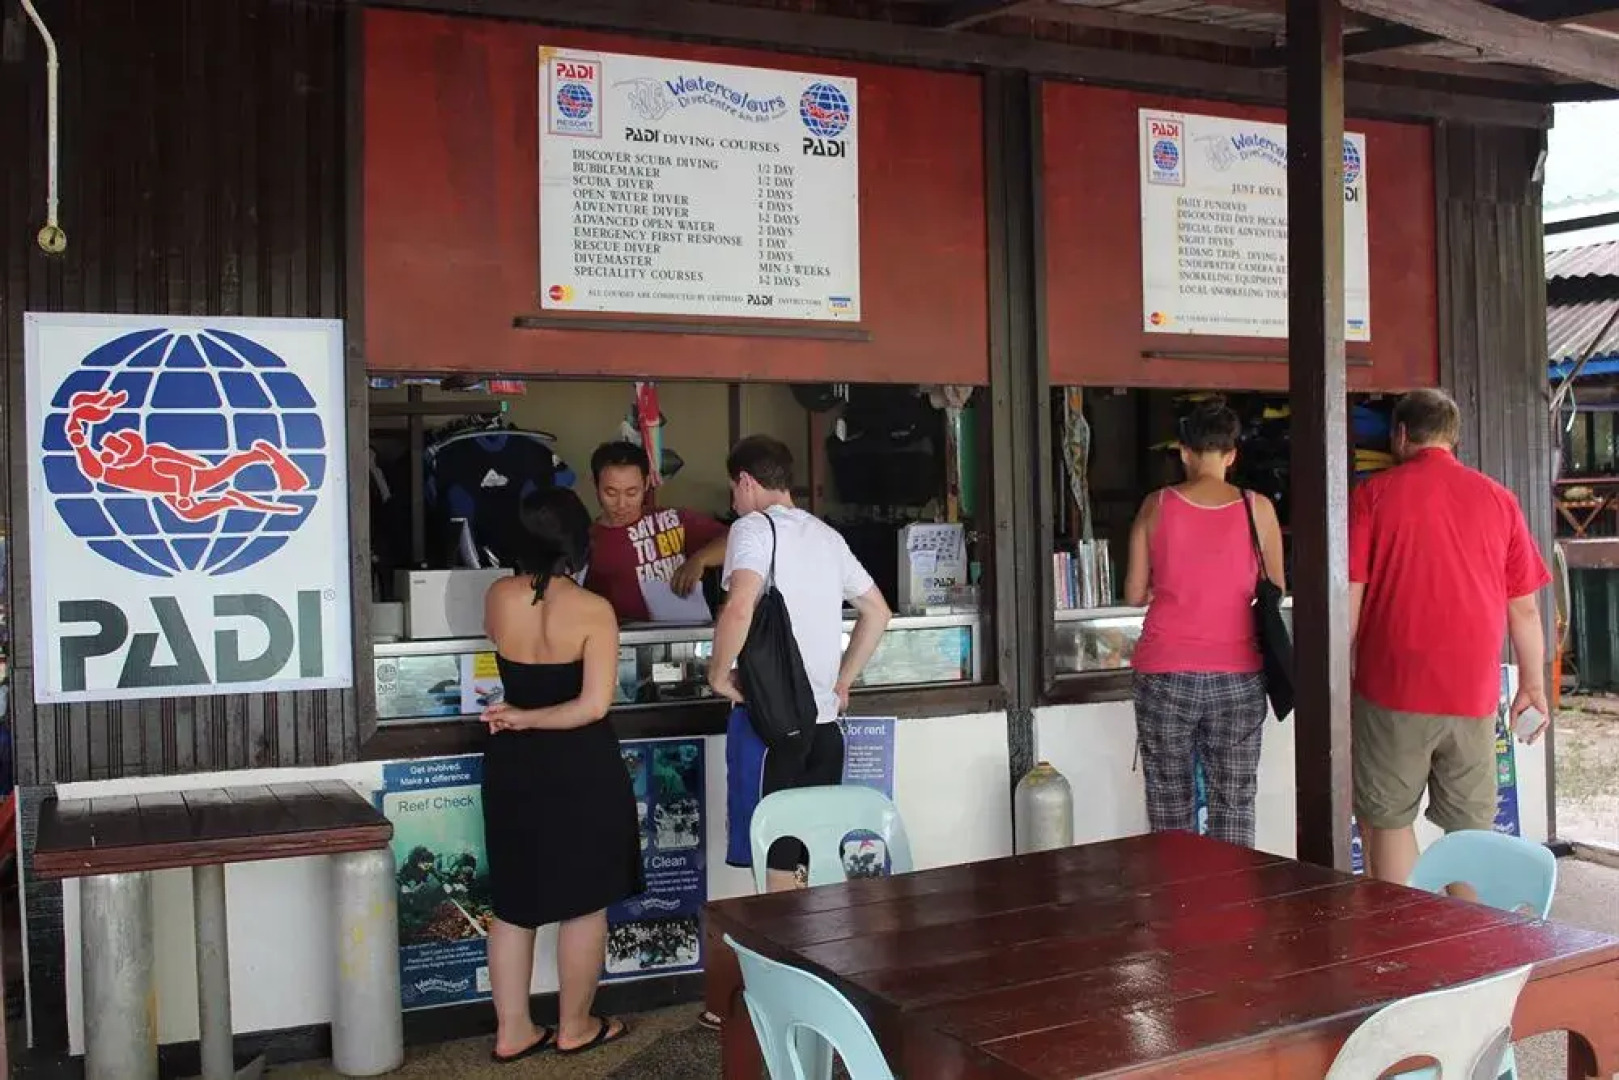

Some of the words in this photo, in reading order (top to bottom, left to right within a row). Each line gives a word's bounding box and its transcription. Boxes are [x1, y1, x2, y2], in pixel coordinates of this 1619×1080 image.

[557, 63, 593, 79] PADI
[666, 76, 785, 112] Watercolours
[1152, 123, 1178, 136] PADI
[625, 127, 659, 142] PADI
[663, 134, 715, 148] DIVING
[719, 138, 780, 153] COURSES
[1231, 133, 1287, 160] Waterco
[803, 137, 845, 158] PADI
[573, 150, 631, 163] DISCOVER
[634, 154, 672, 167] SCUBA
[676, 157, 719, 170] DIVING
[573, 162, 660, 178] BUBBLEMAKER
[774, 164, 794, 175] DAY
[573, 176, 611, 187] SCUBA
[617, 177, 654, 190] DIVER
[775, 177, 794, 187] DAY
[573, 188, 604, 200] OPEN
[610, 191, 648, 203] WATER
[653, 193, 689, 206] DIVER
[767, 189, 793, 200] DAYS
[1231, 183, 1255, 195] JUST
[1259, 186, 1282, 197] DIVE
[1344, 187, 1358, 202] DI
[573, 201, 648, 215] ADVENTURE
[653, 205, 689, 218] DIVER
[767, 201, 793, 212] DAYS
[1177, 197, 1202, 208] DAILY
[573, 214, 638, 228] ADVANCED
[642, 217, 673, 229] OPEN
[678, 220, 715, 232] WATER
[774, 214, 800, 225] DAYS
[1177, 210, 1233, 223] DISCOUNTED
[1235, 214, 1254, 225] DIVE
[1258, 216, 1287, 227] PACKAG
[767, 226, 793, 236] DAYS
[1178, 222, 1211, 234] SPECIAL
[1214, 224, 1235, 236] DIVE
[574, 227, 647, 240] EMERGENCY
[651, 231, 683, 243] FIRST
[687, 233, 743, 247] RESPONSE
[767, 238, 787, 248] DAY
[1178, 235, 1205, 246] NIGHT
[1208, 236, 1234, 248] DIVES
[574, 240, 620, 252] RESCUE
[624, 242, 661, 254] DIVER
[574, 253, 652, 266] DIVEMASTER
[767, 250, 793, 261] DAYS
[1178, 247, 1213, 258] REDANG
[1247, 251, 1278, 262] DIVING
[759, 263, 781, 273] MIN
[794, 265, 831, 276] WEEKS
[1179, 259, 1235, 270] UNDERWATER
[1238, 262, 1274, 273] CAMERA
[1276, 265, 1287, 274] RE
[574, 266, 647, 279] SPECIALITY
[650, 269, 704, 282] COURSES
[1235, 274, 1283, 286] EQUIPMENT
[774, 276, 801, 287] DAYS
[1179, 285, 1208, 296] LOCAL
[747, 294, 773, 306] PADI
[626, 515, 655, 542] SAY
[655, 508, 680, 532] YES
[633, 538, 657, 564] TO
[656, 524, 685, 558] BUY
[58, 590, 324, 692] PADI
[864, 724, 885, 736] rent
[410, 765, 425, 774] Get
[401, 777, 423, 785] Make
[431, 773, 471, 783] difference
[398, 798, 430, 812] Reef
[433, 795, 475, 809] Check
[652, 856, 686, 868] Clean
